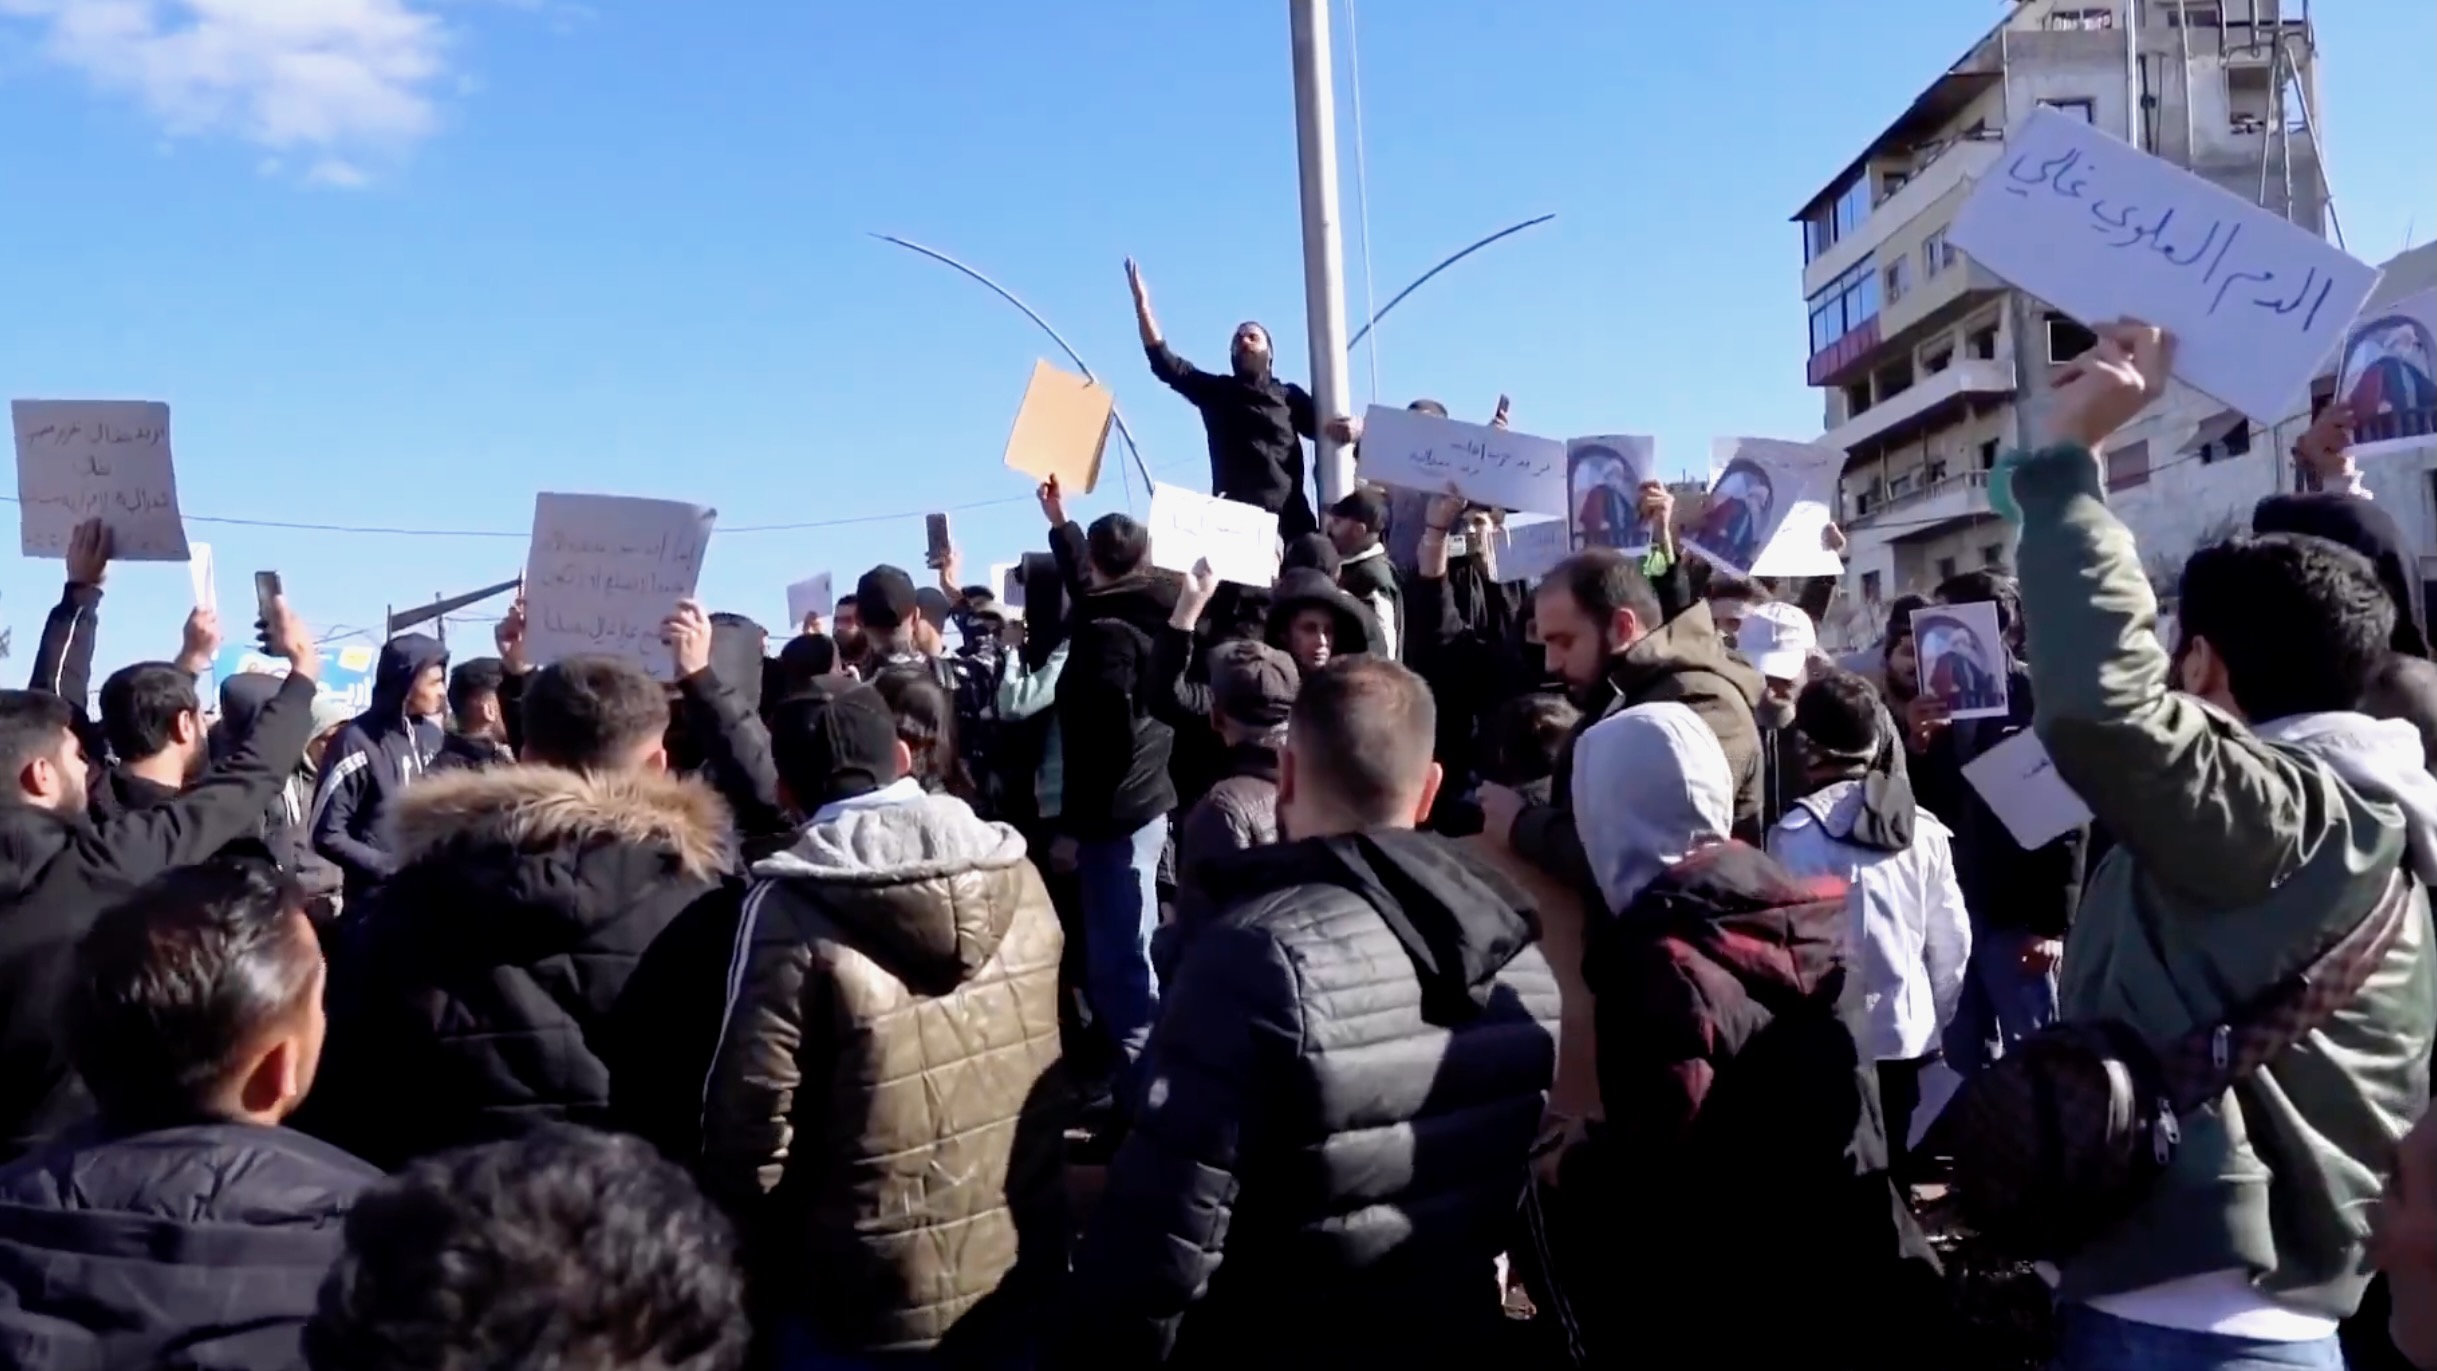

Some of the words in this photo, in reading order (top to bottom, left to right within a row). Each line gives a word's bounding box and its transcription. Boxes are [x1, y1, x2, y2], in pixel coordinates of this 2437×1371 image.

[2005, 147, 2095, 198] غالي
[2091, 200, 2241, 285] العلوي
[2207, 267, 2333, 332] الدم
